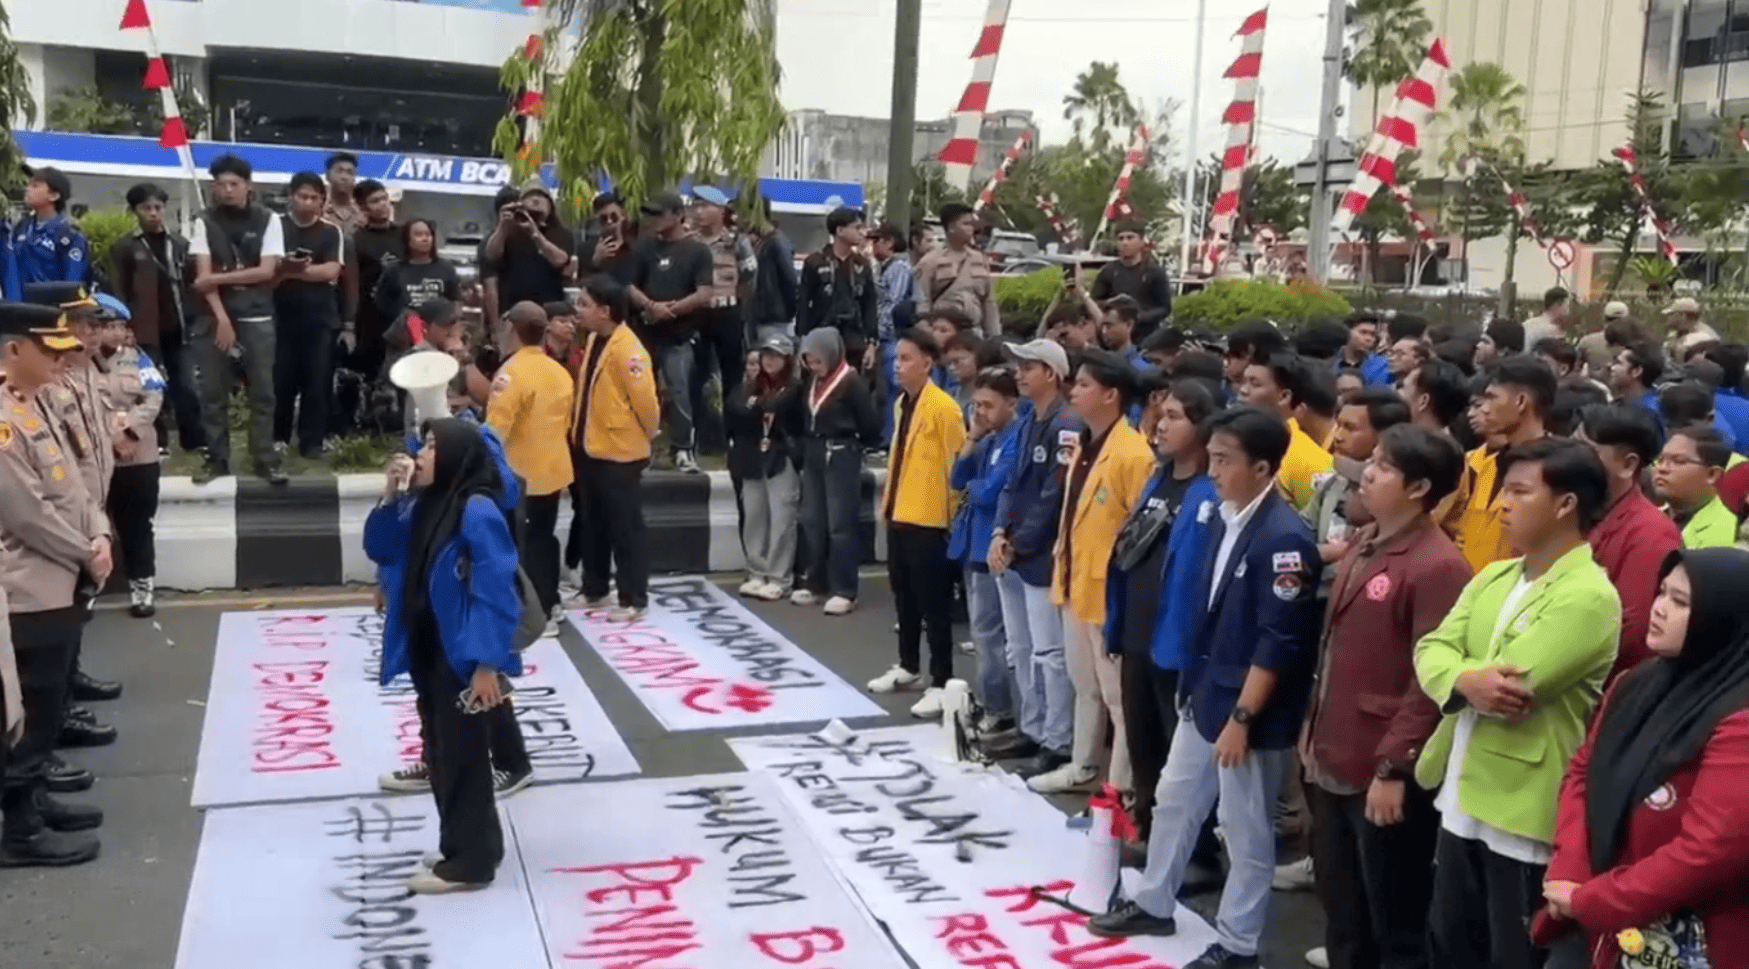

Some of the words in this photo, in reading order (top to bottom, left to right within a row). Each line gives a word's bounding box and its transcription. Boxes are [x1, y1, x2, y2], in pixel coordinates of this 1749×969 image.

[397, 158, 453, 180] ATM
[461, 161, 512, 184] BCA
[650, 580, 826, 690] DEMOKRASI
[252, 660, 342, 773] DEMOKRASI
[664, 784, 808, 909] HUKUM
[747, 926, 845, 969] B
[839, 826, 962, 904] BUKAN
